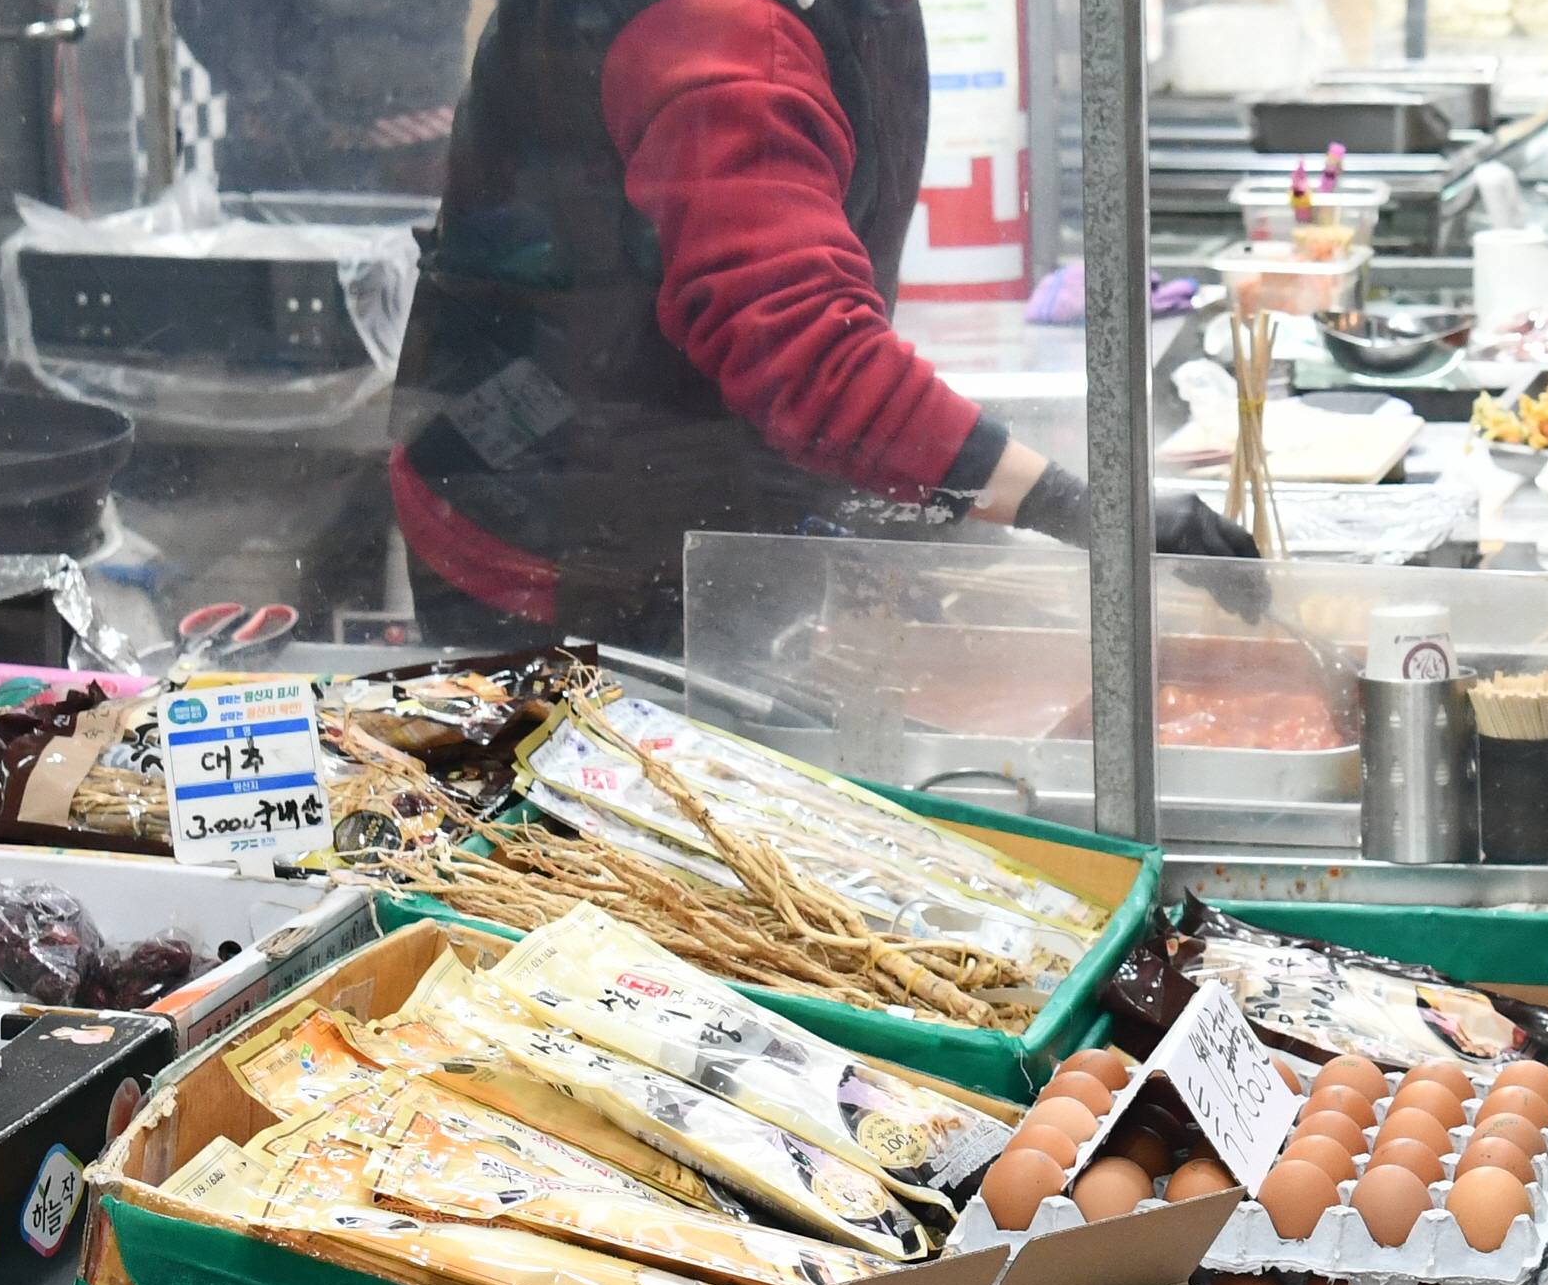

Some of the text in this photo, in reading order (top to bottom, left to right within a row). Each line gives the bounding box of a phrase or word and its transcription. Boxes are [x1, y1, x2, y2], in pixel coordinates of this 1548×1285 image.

[201, 736, 265, 780] 대추
[233, 780, 260, 792] 원산지
[31, 1169, 77, 1239] 하늘작
